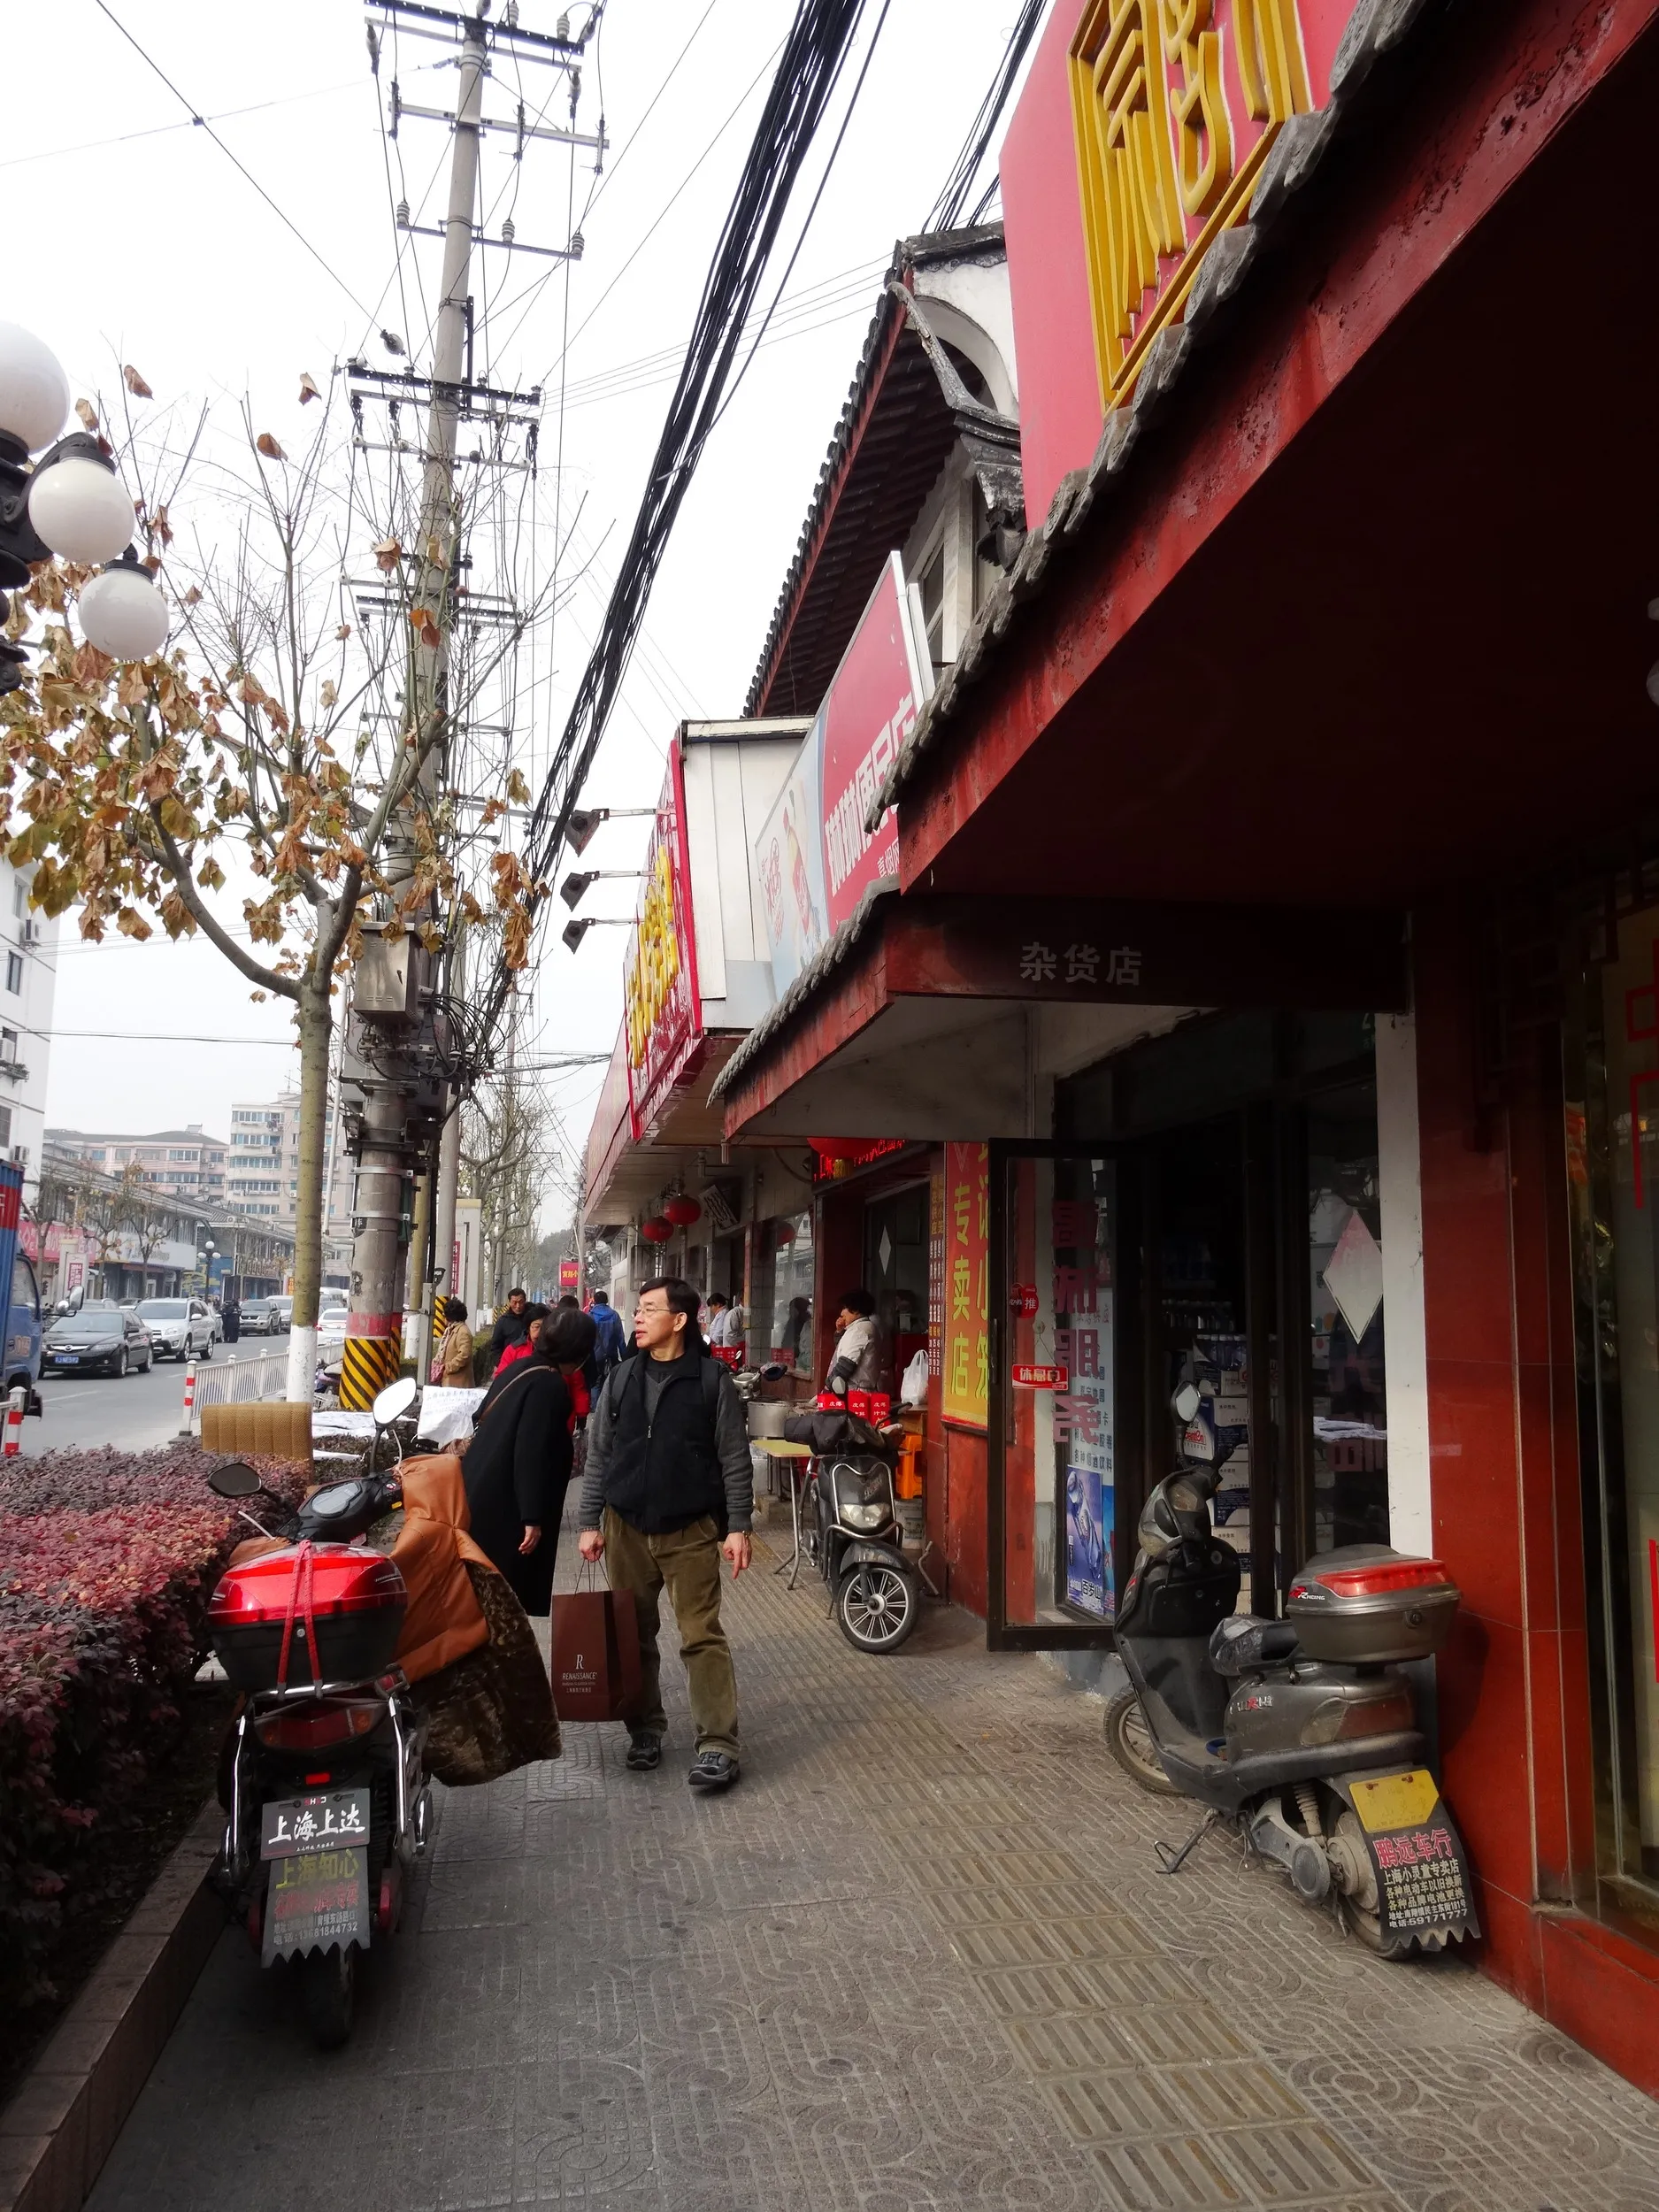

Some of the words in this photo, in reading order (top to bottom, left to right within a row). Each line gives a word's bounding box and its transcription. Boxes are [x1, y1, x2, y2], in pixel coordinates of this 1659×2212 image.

[1019, 941, 1142, 986] 杂货店
[950, 1181, 972, 1396] 专卖店
[1024, 1297, 1037, 1310] 推
[1019, 1367, 1061, 1382] 休息中
[575, 1654, 584, 1670] R
[268, 1803, 366, 1845] 上海上达
[1372, 1827, 1454, 1870] 鹏远车行
[1383, 1857, 1461, 1886] 上海小灵童专卖店
[1386, 1873, 1463, 1901] 各种电动车以旧换新
[1387, 1886, 1466, 1912] 各种品牌电池更换
